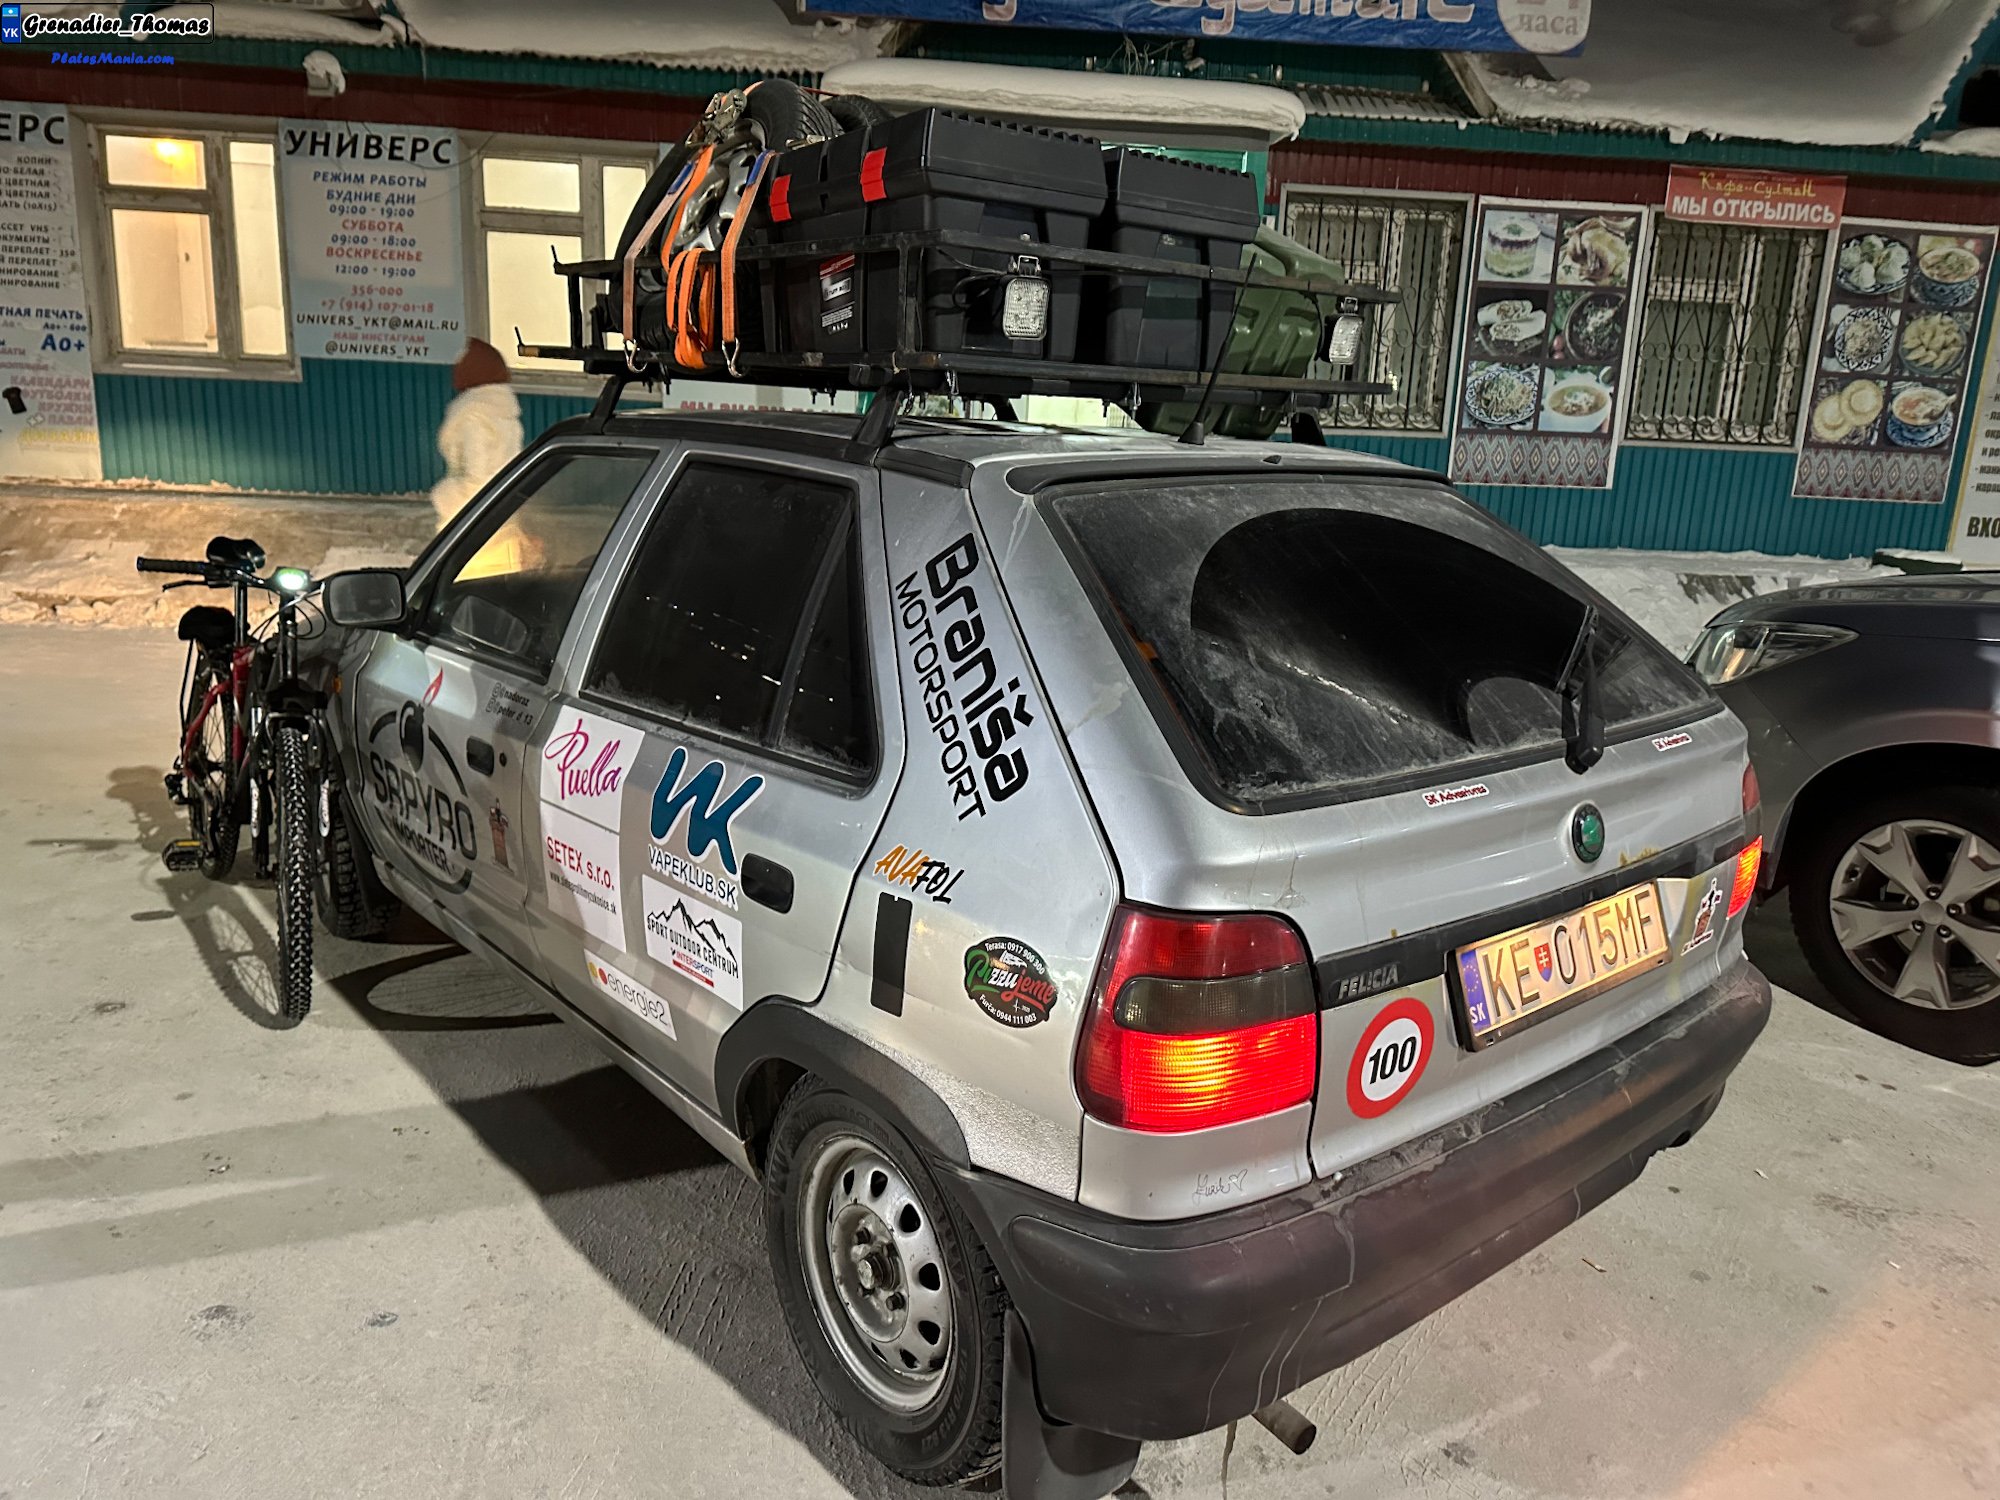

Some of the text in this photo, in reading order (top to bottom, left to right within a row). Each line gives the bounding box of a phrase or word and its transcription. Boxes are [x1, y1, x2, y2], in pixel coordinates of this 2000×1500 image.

[286, 129, 452, 164] УНИВЕРС
[313, 171, 427, 188] РЕЖИМ РАБОТЫ
[326, 189, 416, 206] БУДНИЕ ДНИ
[329, 204, 366, 216] 09:00
[381, 206, 414, 218] 19:00
[1672, 195, 1836, 224] МЫ ОТКРЫЛИСЬ
[331, 234, 369, 245] 09:00
[382, 235, 416, 247] 18:00
[342, 219, 404, 233] СУББОТА
[2, 245, 50, 255] ПЕРЕПЛЕТ
[326, 247, 423, 262] ВОСКРЕСЕНЬЕ
[335, 265, 369, 275] 12:00
[382, 266, 416, 278] 19:00
[36, 308, 83, 320] ПЕЧАТЬ
[925, 532, 1034, 802] Braniša
[895, 570, 987, 822] MOTORSPORT
[545, 719, 622, 800] Puella
[547, 836, 614, 890] SETEX s.r.o.
[648, 846, 737, 905] VAPEKLUB.SK
[647, 917, 668, 939] SPORT
[669, 929, 701, 958] OUTDOOR
[703, 946, 739, 979] CENTRUM
[985, 942, 1045, 975] Terasa: 0917 900 300
[1483, 889, 1652, 1018] KE 015MF
[676, 951, 714, 978] INTERSPORT
[1338, 964, 1399, 1000] FELICIA
[980, 994, 1037, 1024] Furča: 0944 111 003
[1469, 1003, 1486, 1024] SK
[1368, 1036, 1417, 1085] 100
